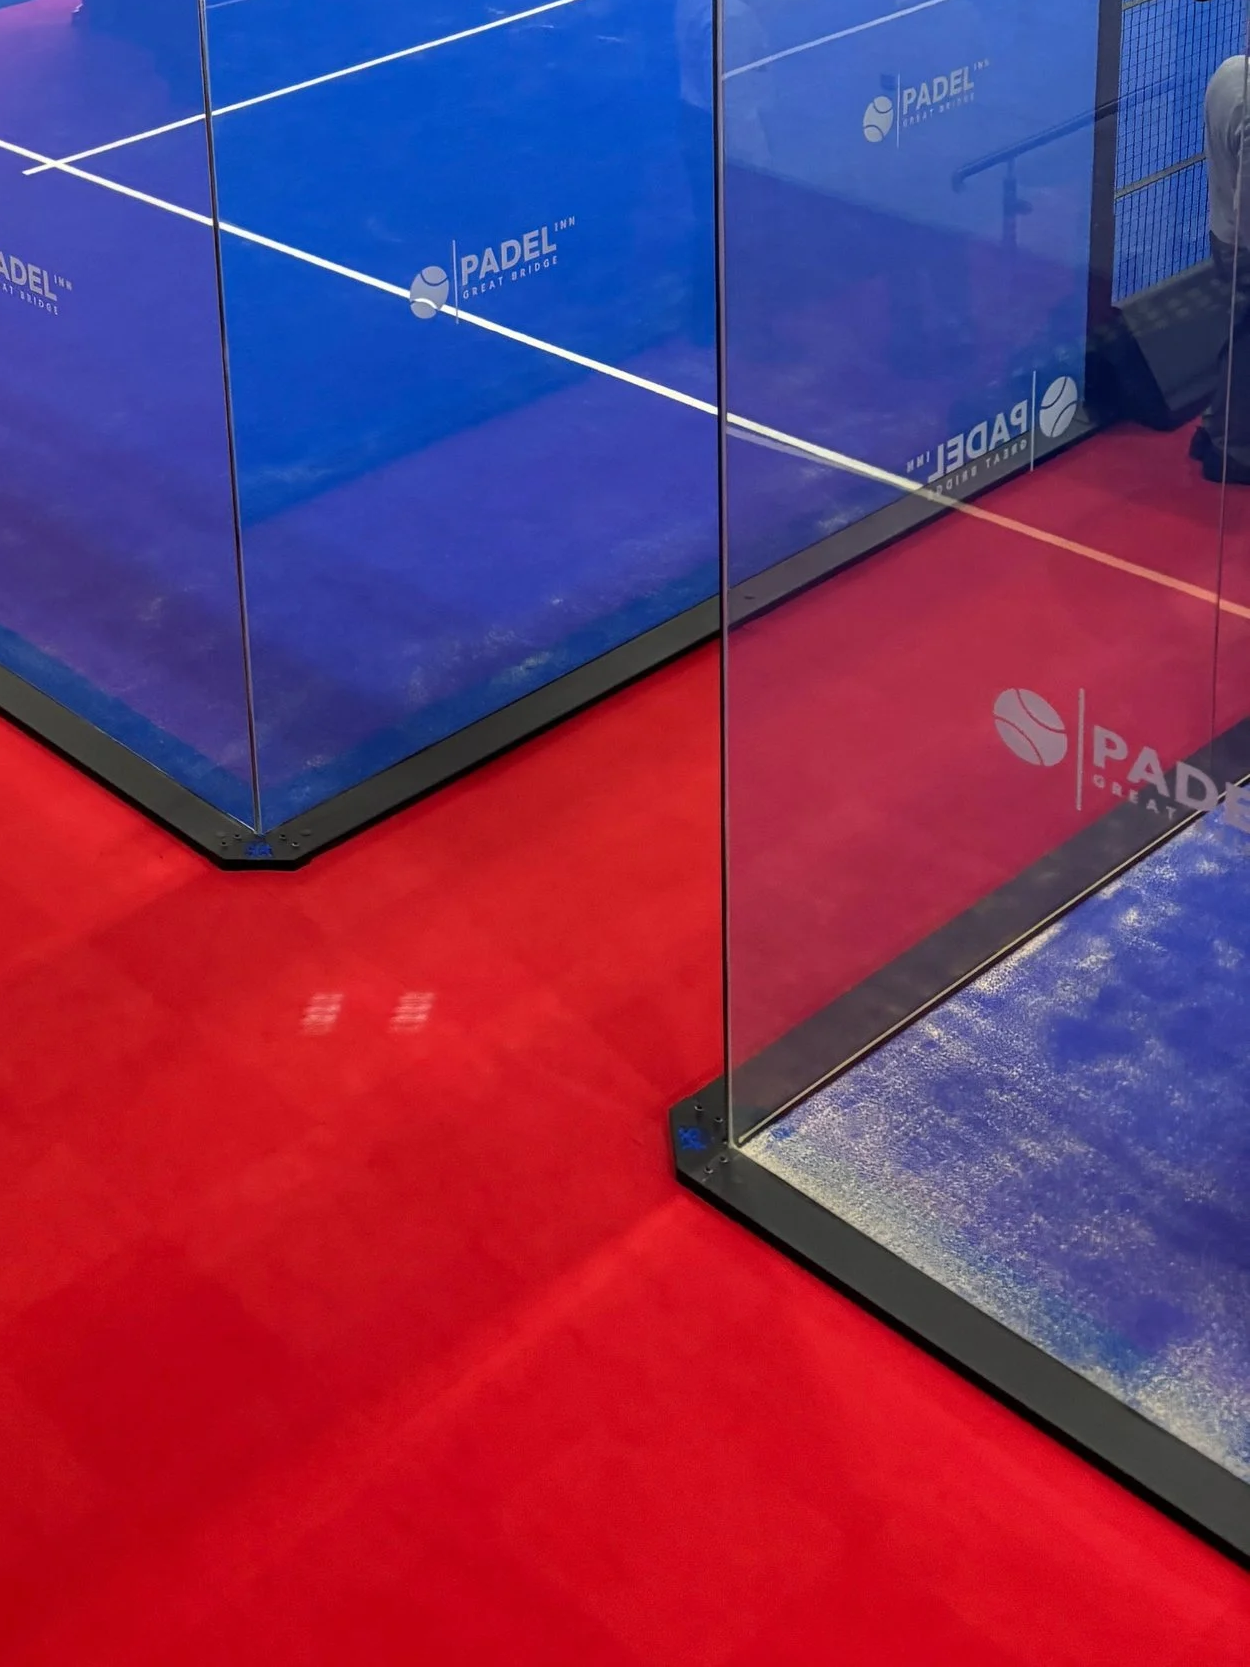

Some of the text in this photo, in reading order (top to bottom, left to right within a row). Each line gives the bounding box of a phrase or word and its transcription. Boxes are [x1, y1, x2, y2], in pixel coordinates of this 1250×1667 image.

[903, 66, 975, 115] PADEL
[461, 216, 576, 286] PADEL INN
[463, 255, 558, 300] GREAT BRIDGE
[20, 291, 59, 315] BRIDGE
[1093, 774, 1177, 820] GREAT
